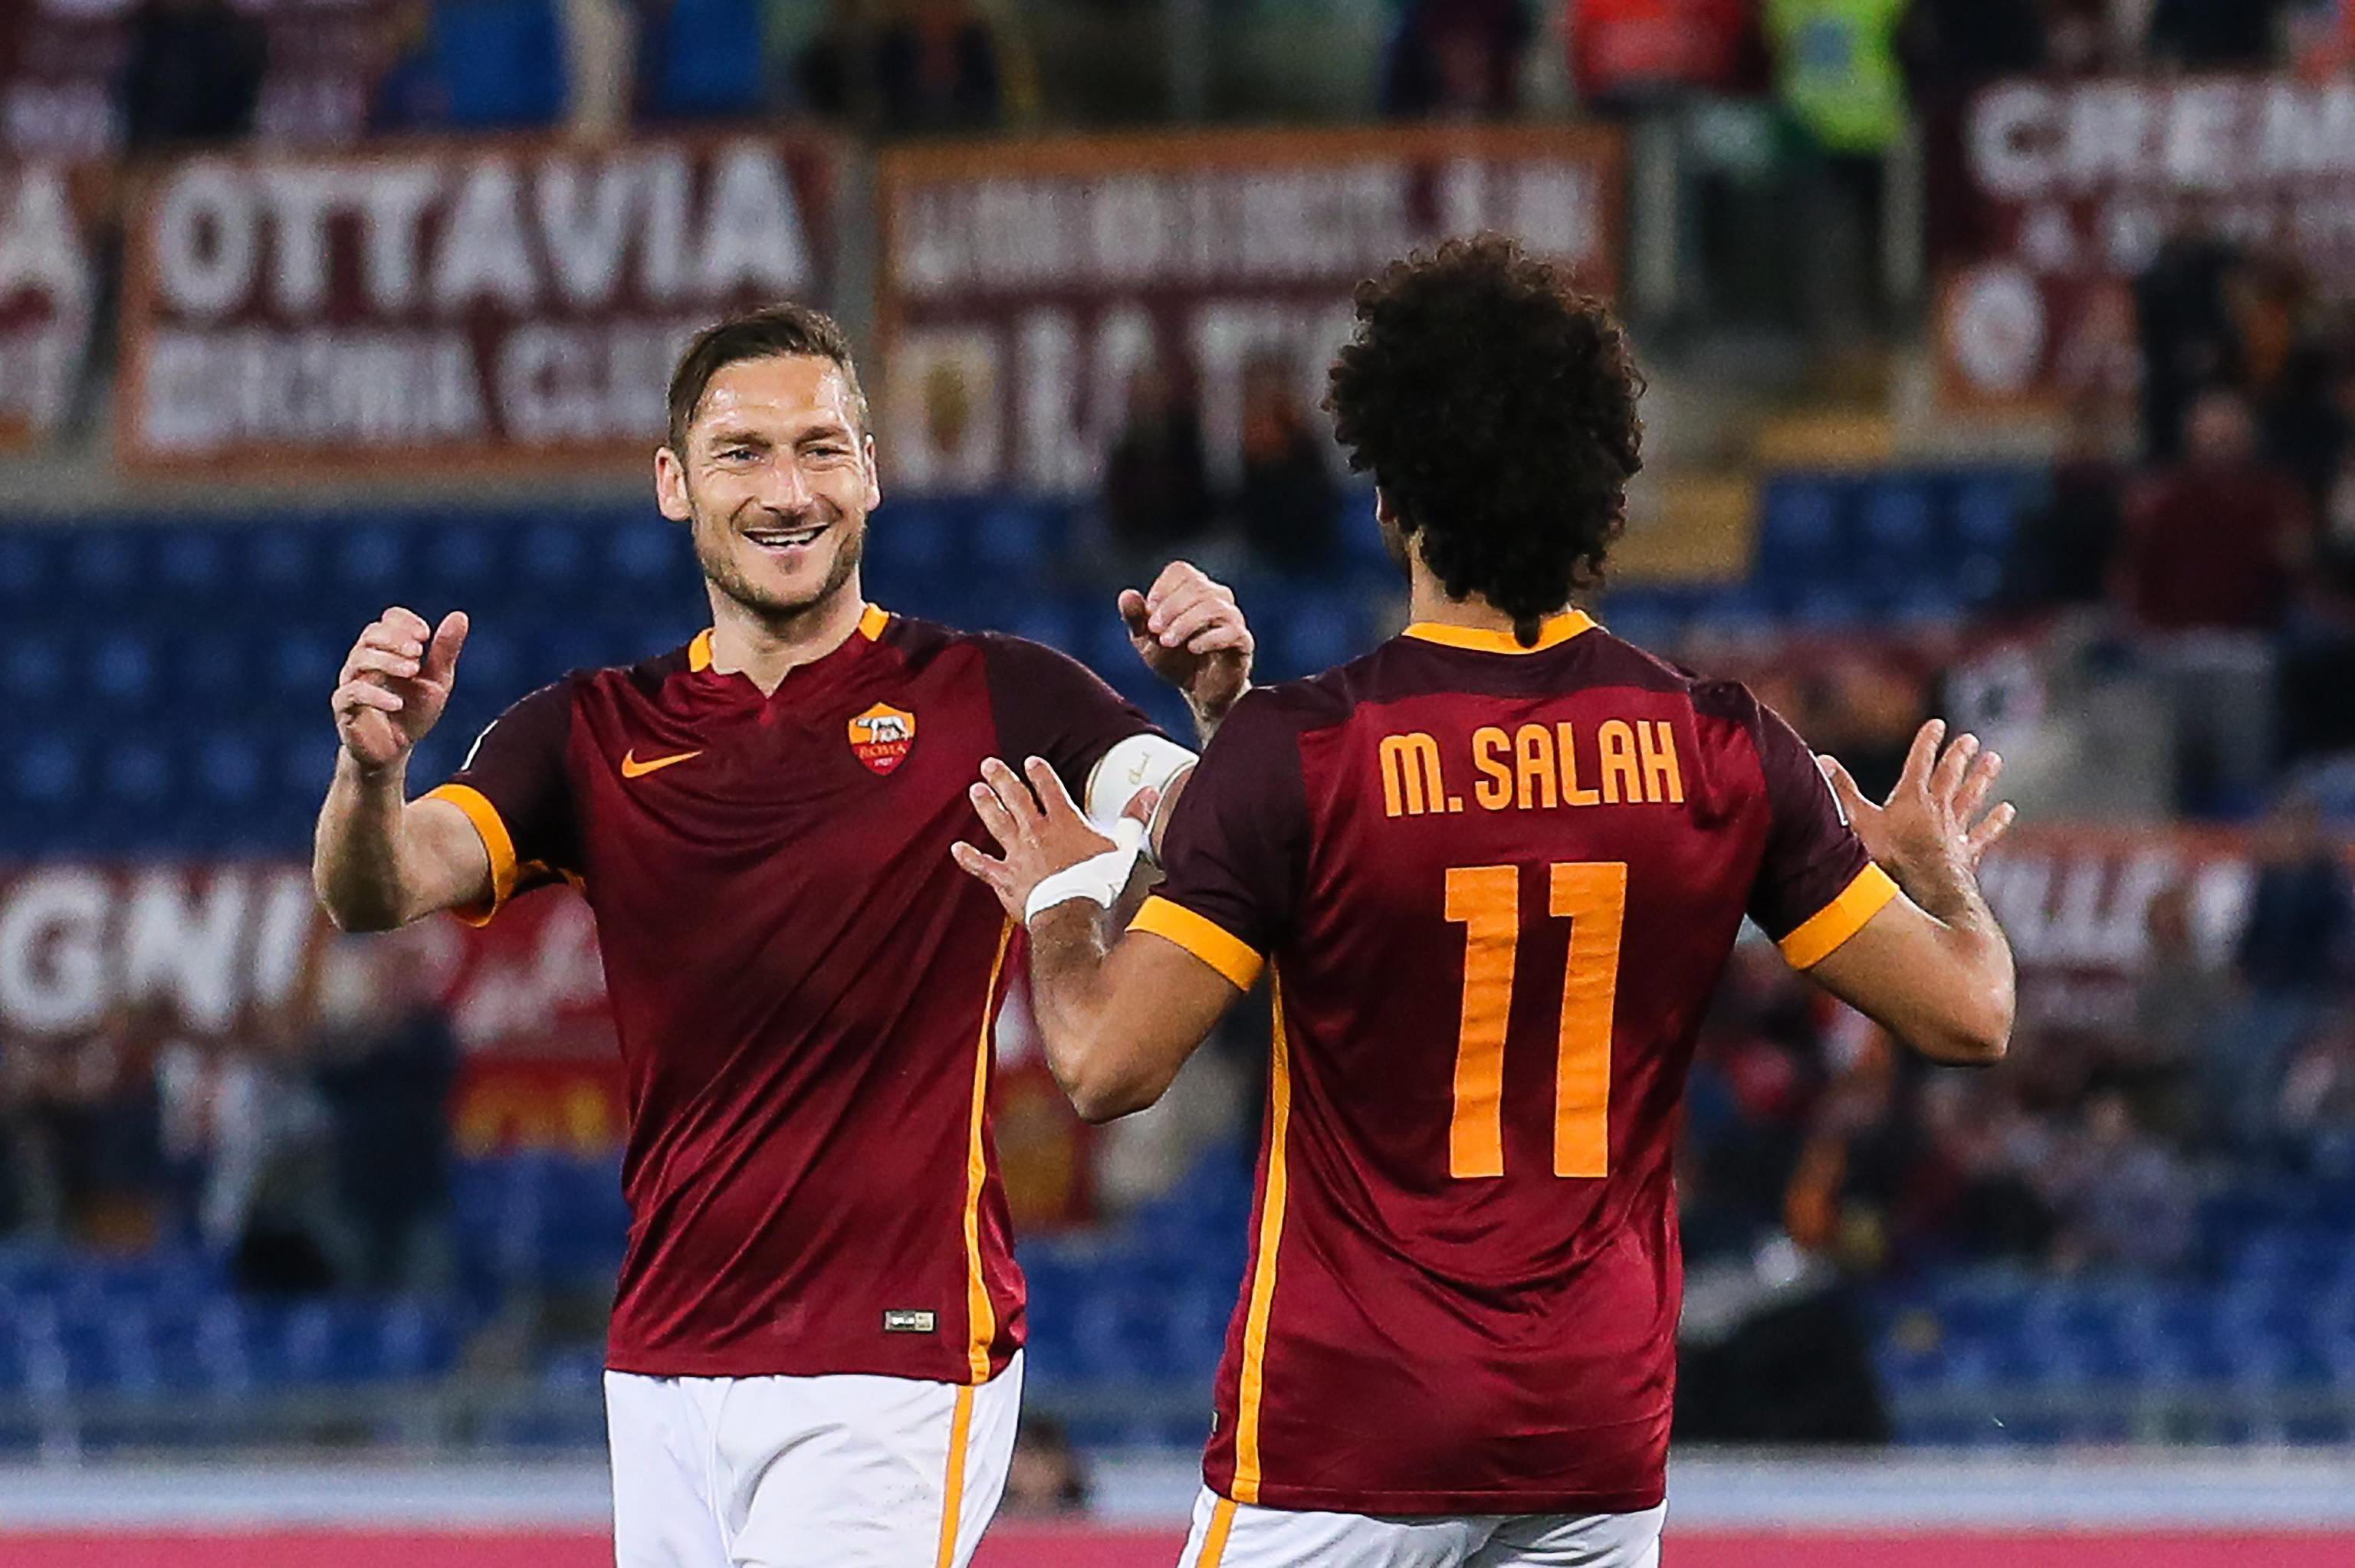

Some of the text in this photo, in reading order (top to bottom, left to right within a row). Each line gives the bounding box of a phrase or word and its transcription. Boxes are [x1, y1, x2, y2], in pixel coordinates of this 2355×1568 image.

[158, 139, 813, 312] OTTAVIA
[1379, 720, 1684, 817] M. SALAH
[1445, 861, 1627, 1178] 11
